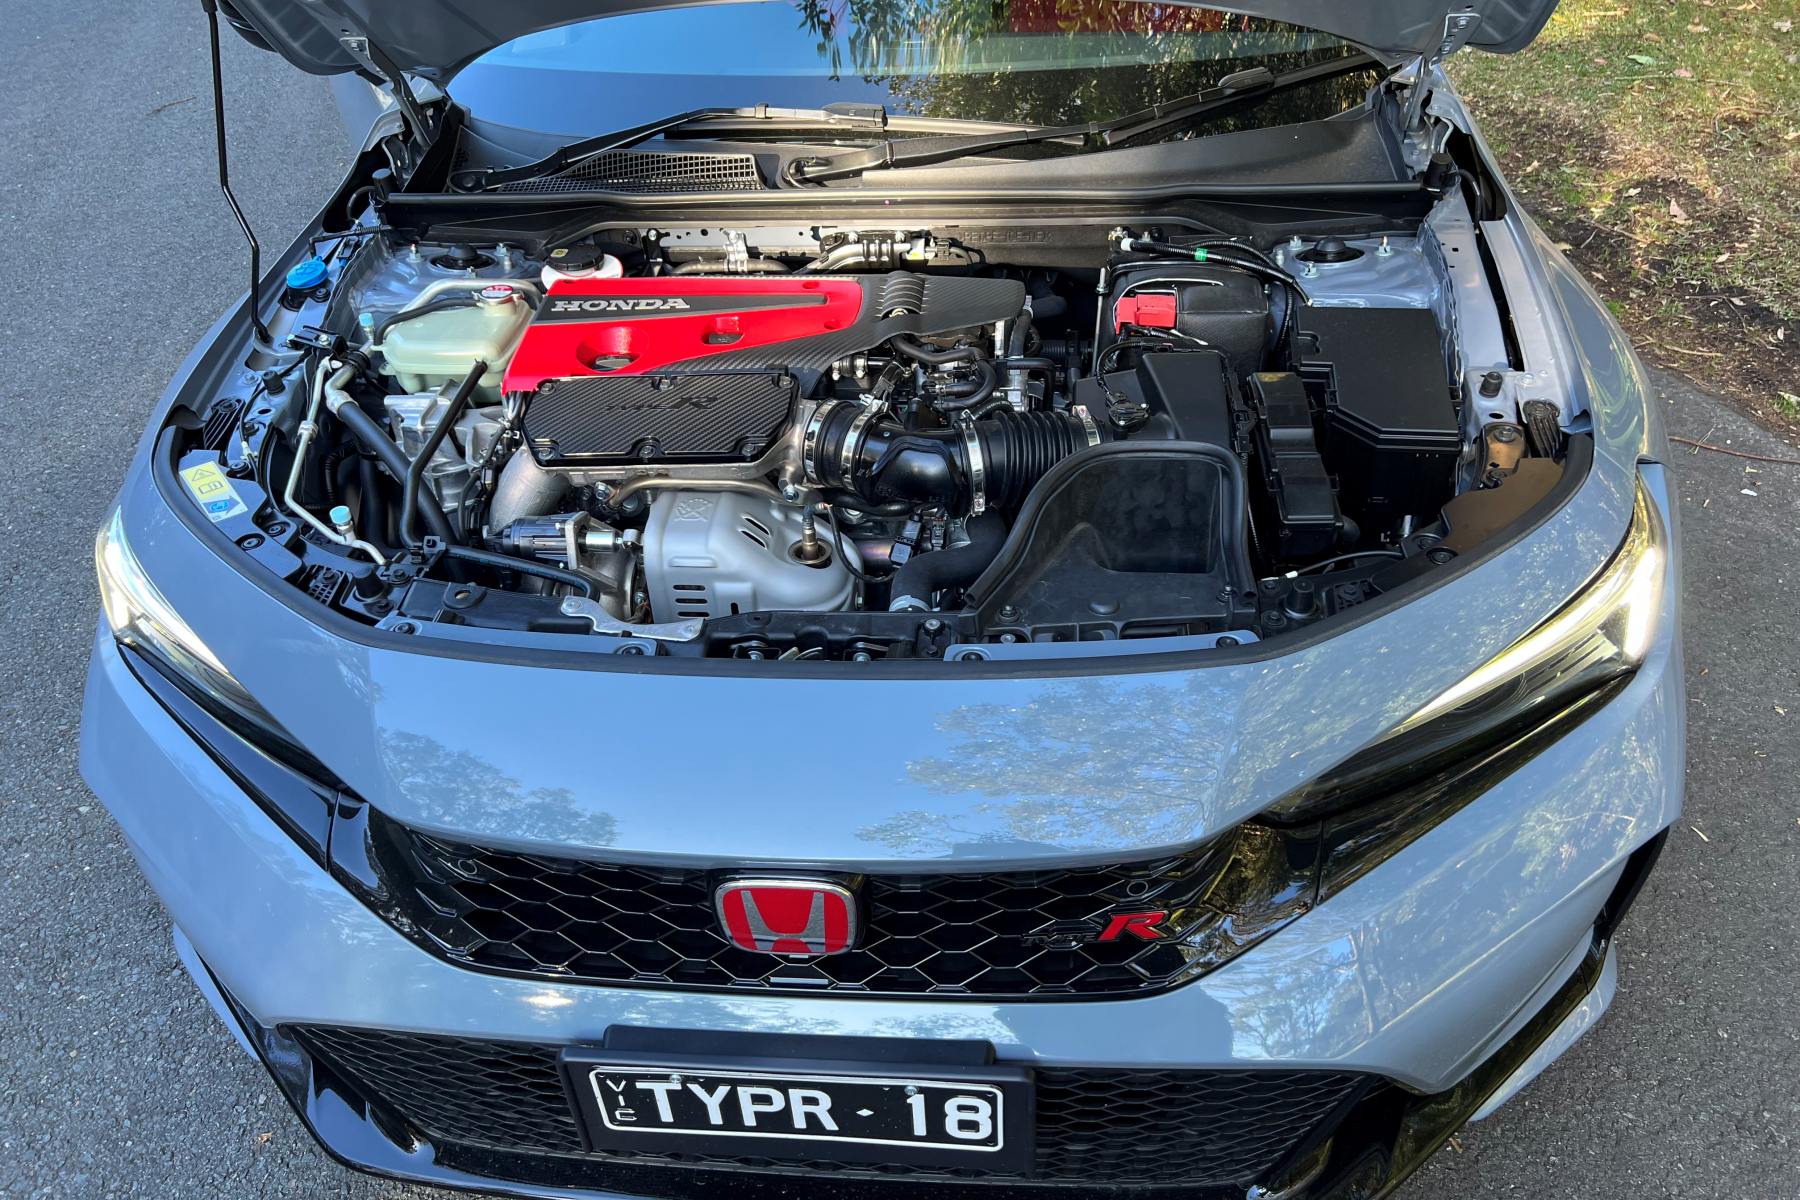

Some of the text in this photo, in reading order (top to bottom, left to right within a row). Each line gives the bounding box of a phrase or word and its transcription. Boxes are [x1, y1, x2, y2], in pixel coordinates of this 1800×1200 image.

[551, 298, 690, 311] HONDA
[1097, 909, 1170, 942] R
[606, 1079, 638, 1121] VIC
[635, 1081, 993, 1140] TYPR 18
